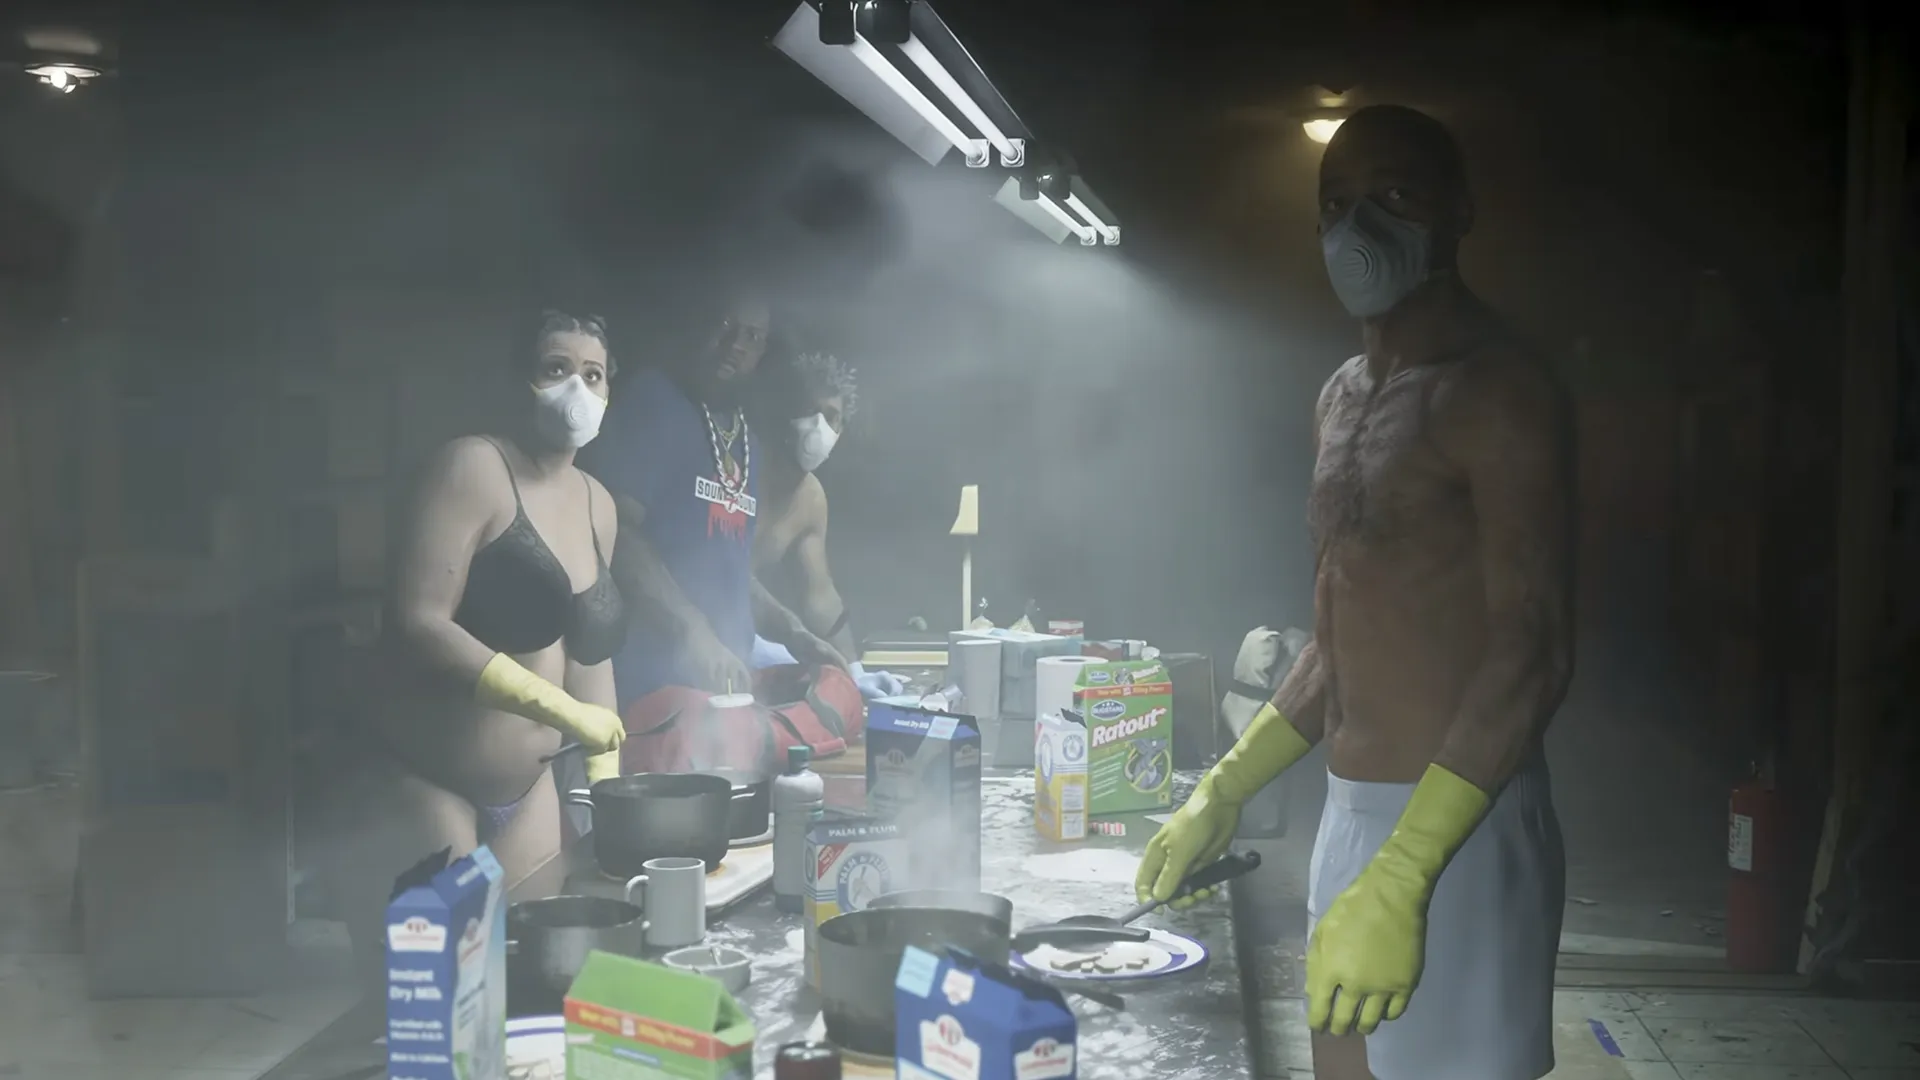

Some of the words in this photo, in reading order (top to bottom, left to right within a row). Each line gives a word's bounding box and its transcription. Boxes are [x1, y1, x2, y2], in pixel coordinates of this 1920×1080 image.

[697, 480, 725, 502] SOUN
[1092, 708, 1166, 747] Ratout
[828, 827, 857, 837] PALM
[389, 985, 413, 1003] Dry
